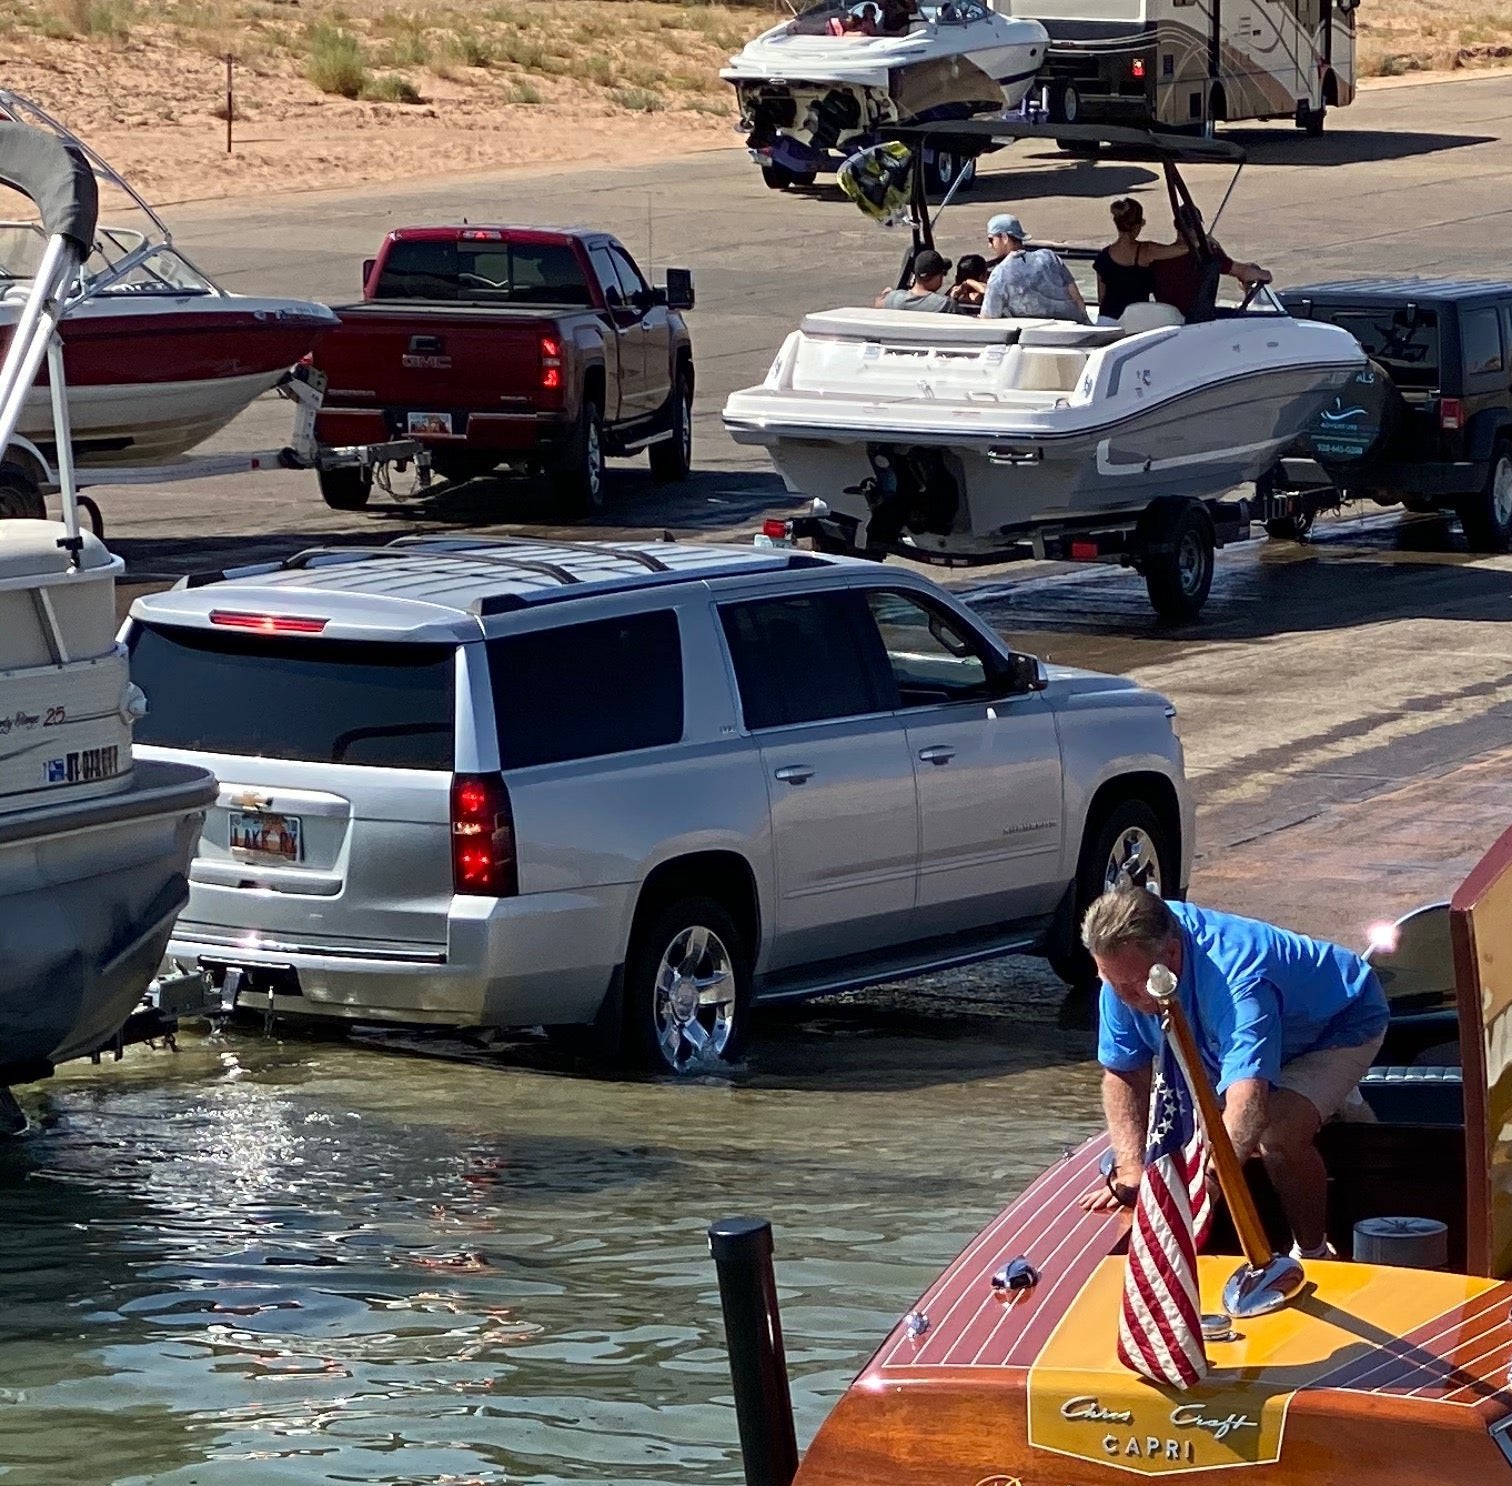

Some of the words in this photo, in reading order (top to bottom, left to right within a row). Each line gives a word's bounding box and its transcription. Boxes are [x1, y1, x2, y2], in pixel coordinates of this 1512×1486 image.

[402, 355, 452, 368] GMC
[43, 705, 66, 727] 25
[1169, 1403, 1258, 1440] Craft
[1102, 1432, 1194, 1463] CAPRI
